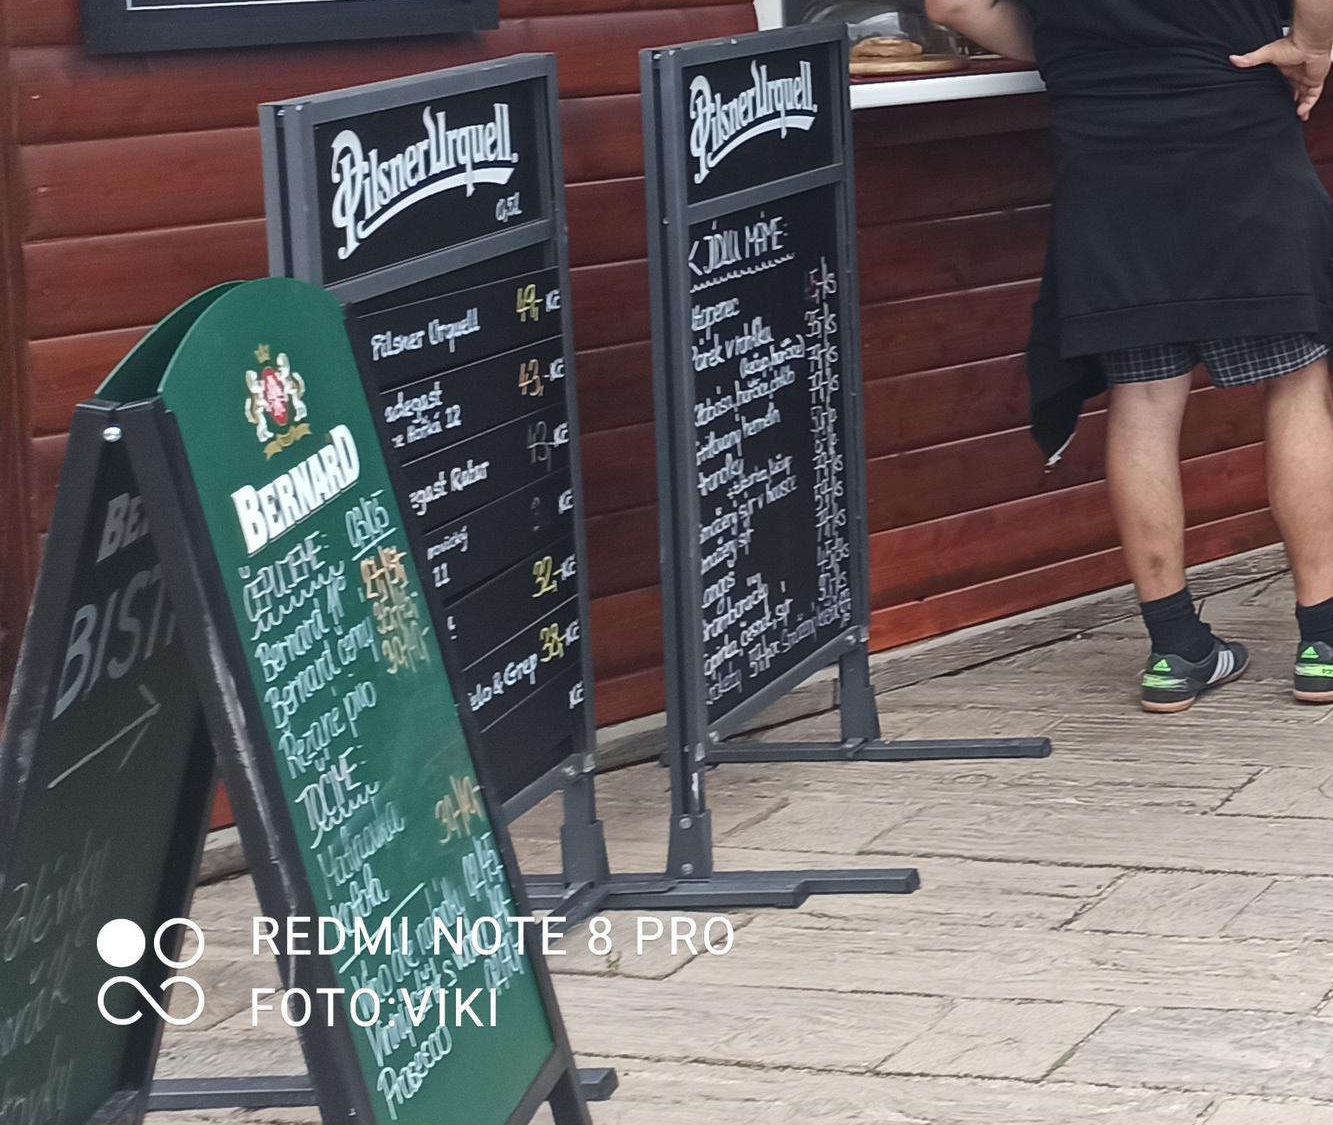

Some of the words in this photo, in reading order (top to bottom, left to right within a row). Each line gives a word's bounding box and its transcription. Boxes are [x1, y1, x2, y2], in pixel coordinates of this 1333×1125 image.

[689, 75, 755, 184] Pilsner
[751, 60, 818, 140] Urquell
[331, 130, 430, 260] Pilsner
[423, 103, 519, 198] Urquell
[371, 330, 425, 361] Pilsner
[428, 308, 480, 353] Urquell
[385, 381, 443, 424] adegast
[445, 404, 462, 428] 12
[231, 424, 361, 558] BERNARD
[255, 598, 330, 683] Bernard
[264, 640, 342, 729] Bernard
